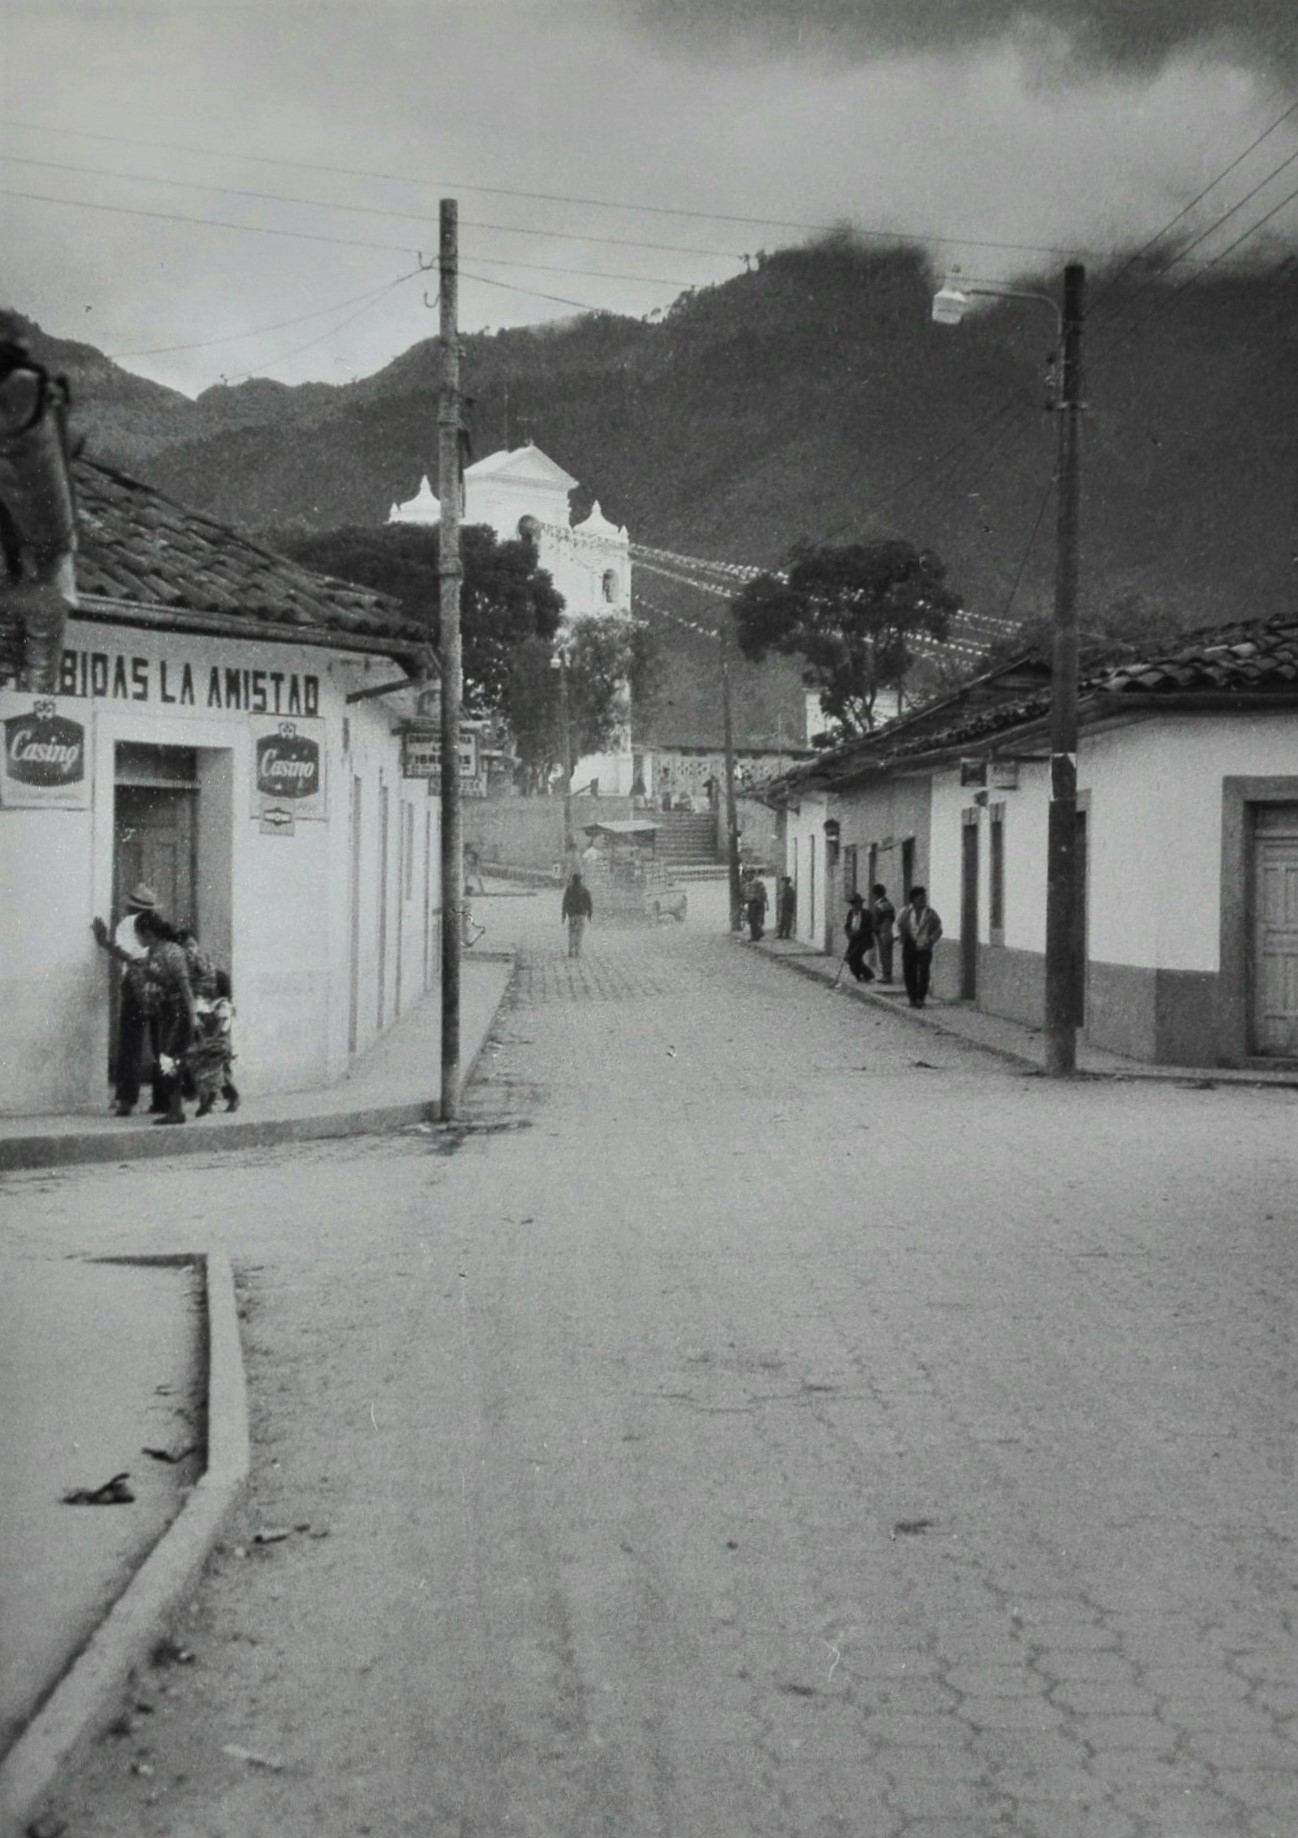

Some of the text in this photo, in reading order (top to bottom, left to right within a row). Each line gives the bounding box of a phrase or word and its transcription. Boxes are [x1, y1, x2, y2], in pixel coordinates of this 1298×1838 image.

[60, 649, 320, 717] BIDAS LA AMISTAD
[10, 729, 81, 772] Casino
[261, 748, 316, 780] Casino
